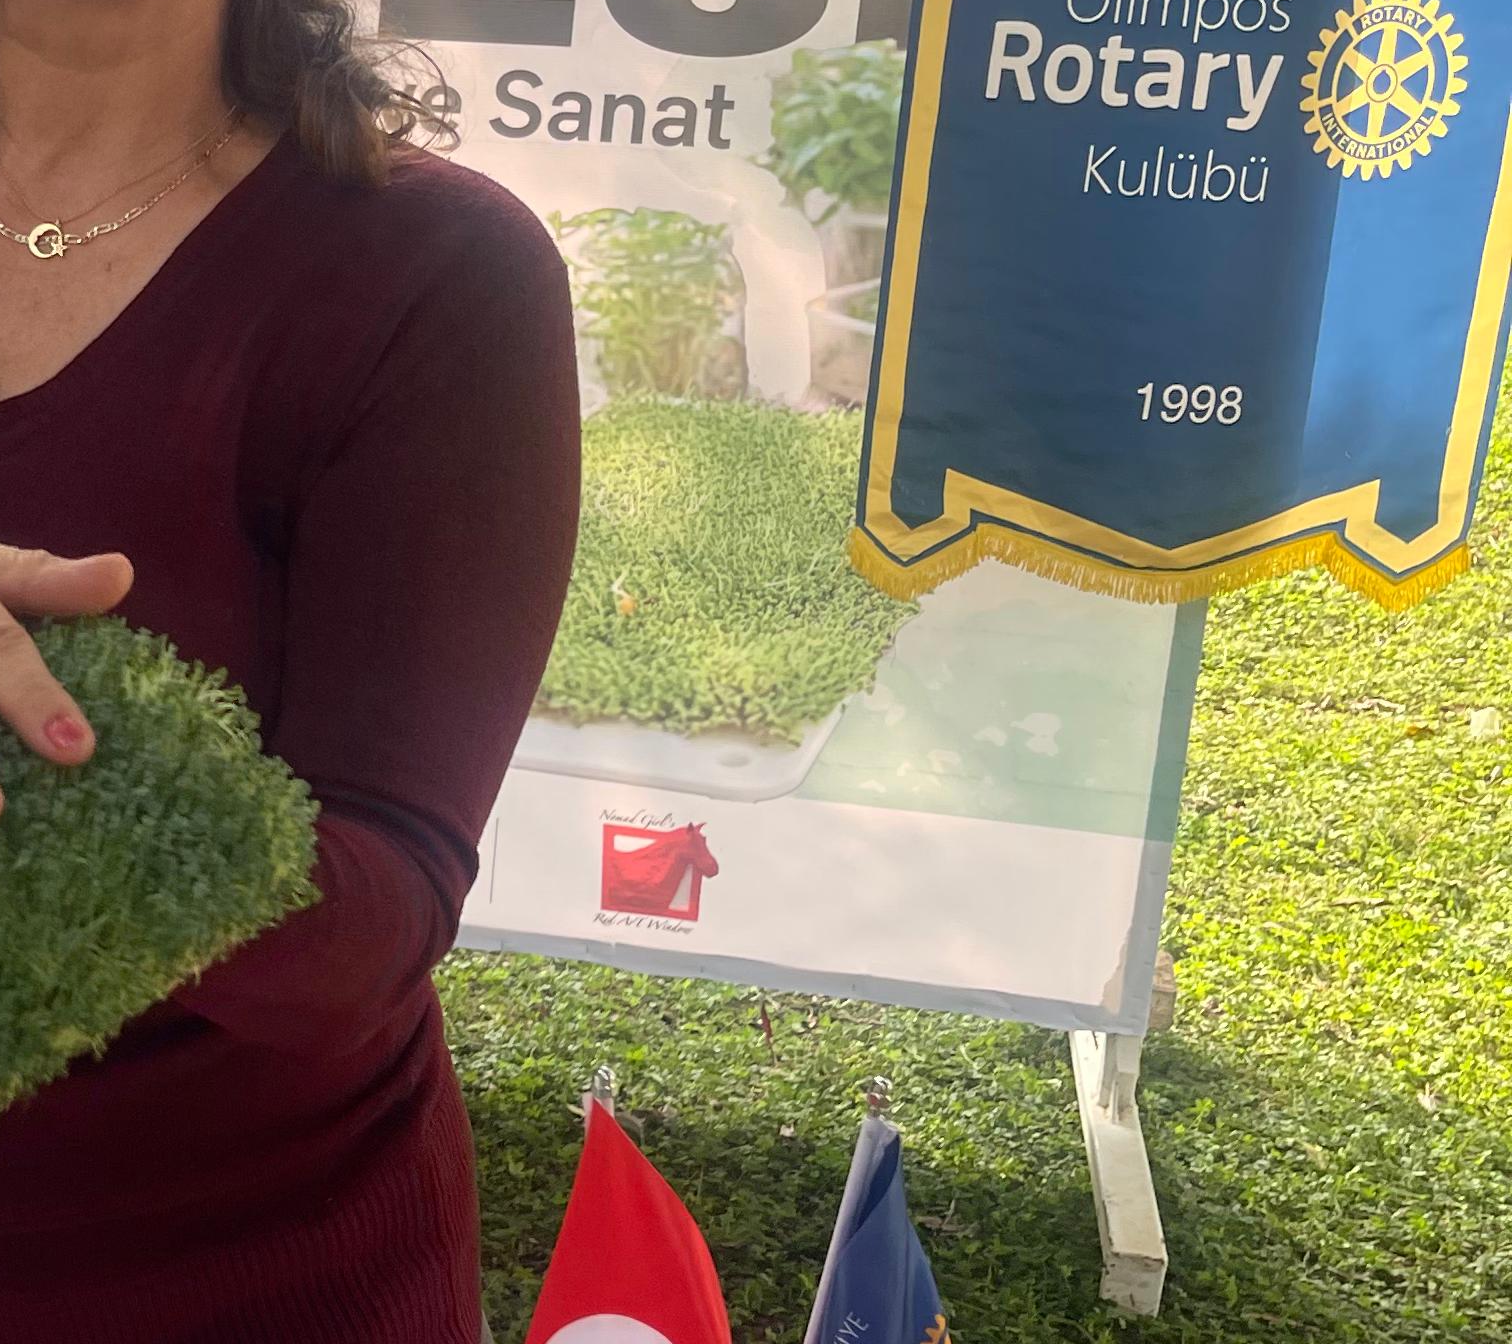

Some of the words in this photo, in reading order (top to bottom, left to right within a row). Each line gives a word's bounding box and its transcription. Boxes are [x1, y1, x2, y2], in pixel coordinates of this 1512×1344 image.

[1361, 7, 1426, 31] ROTARY
[985, 20, 1285, 131] Rotary
[488, 68, 736, 150] Sanat
[1321, 111, 1434, 160] INTERNATIONAL
[1083, 144, 1270, 204] Kulübü
[1135, 382, 1244, 426] 1998
